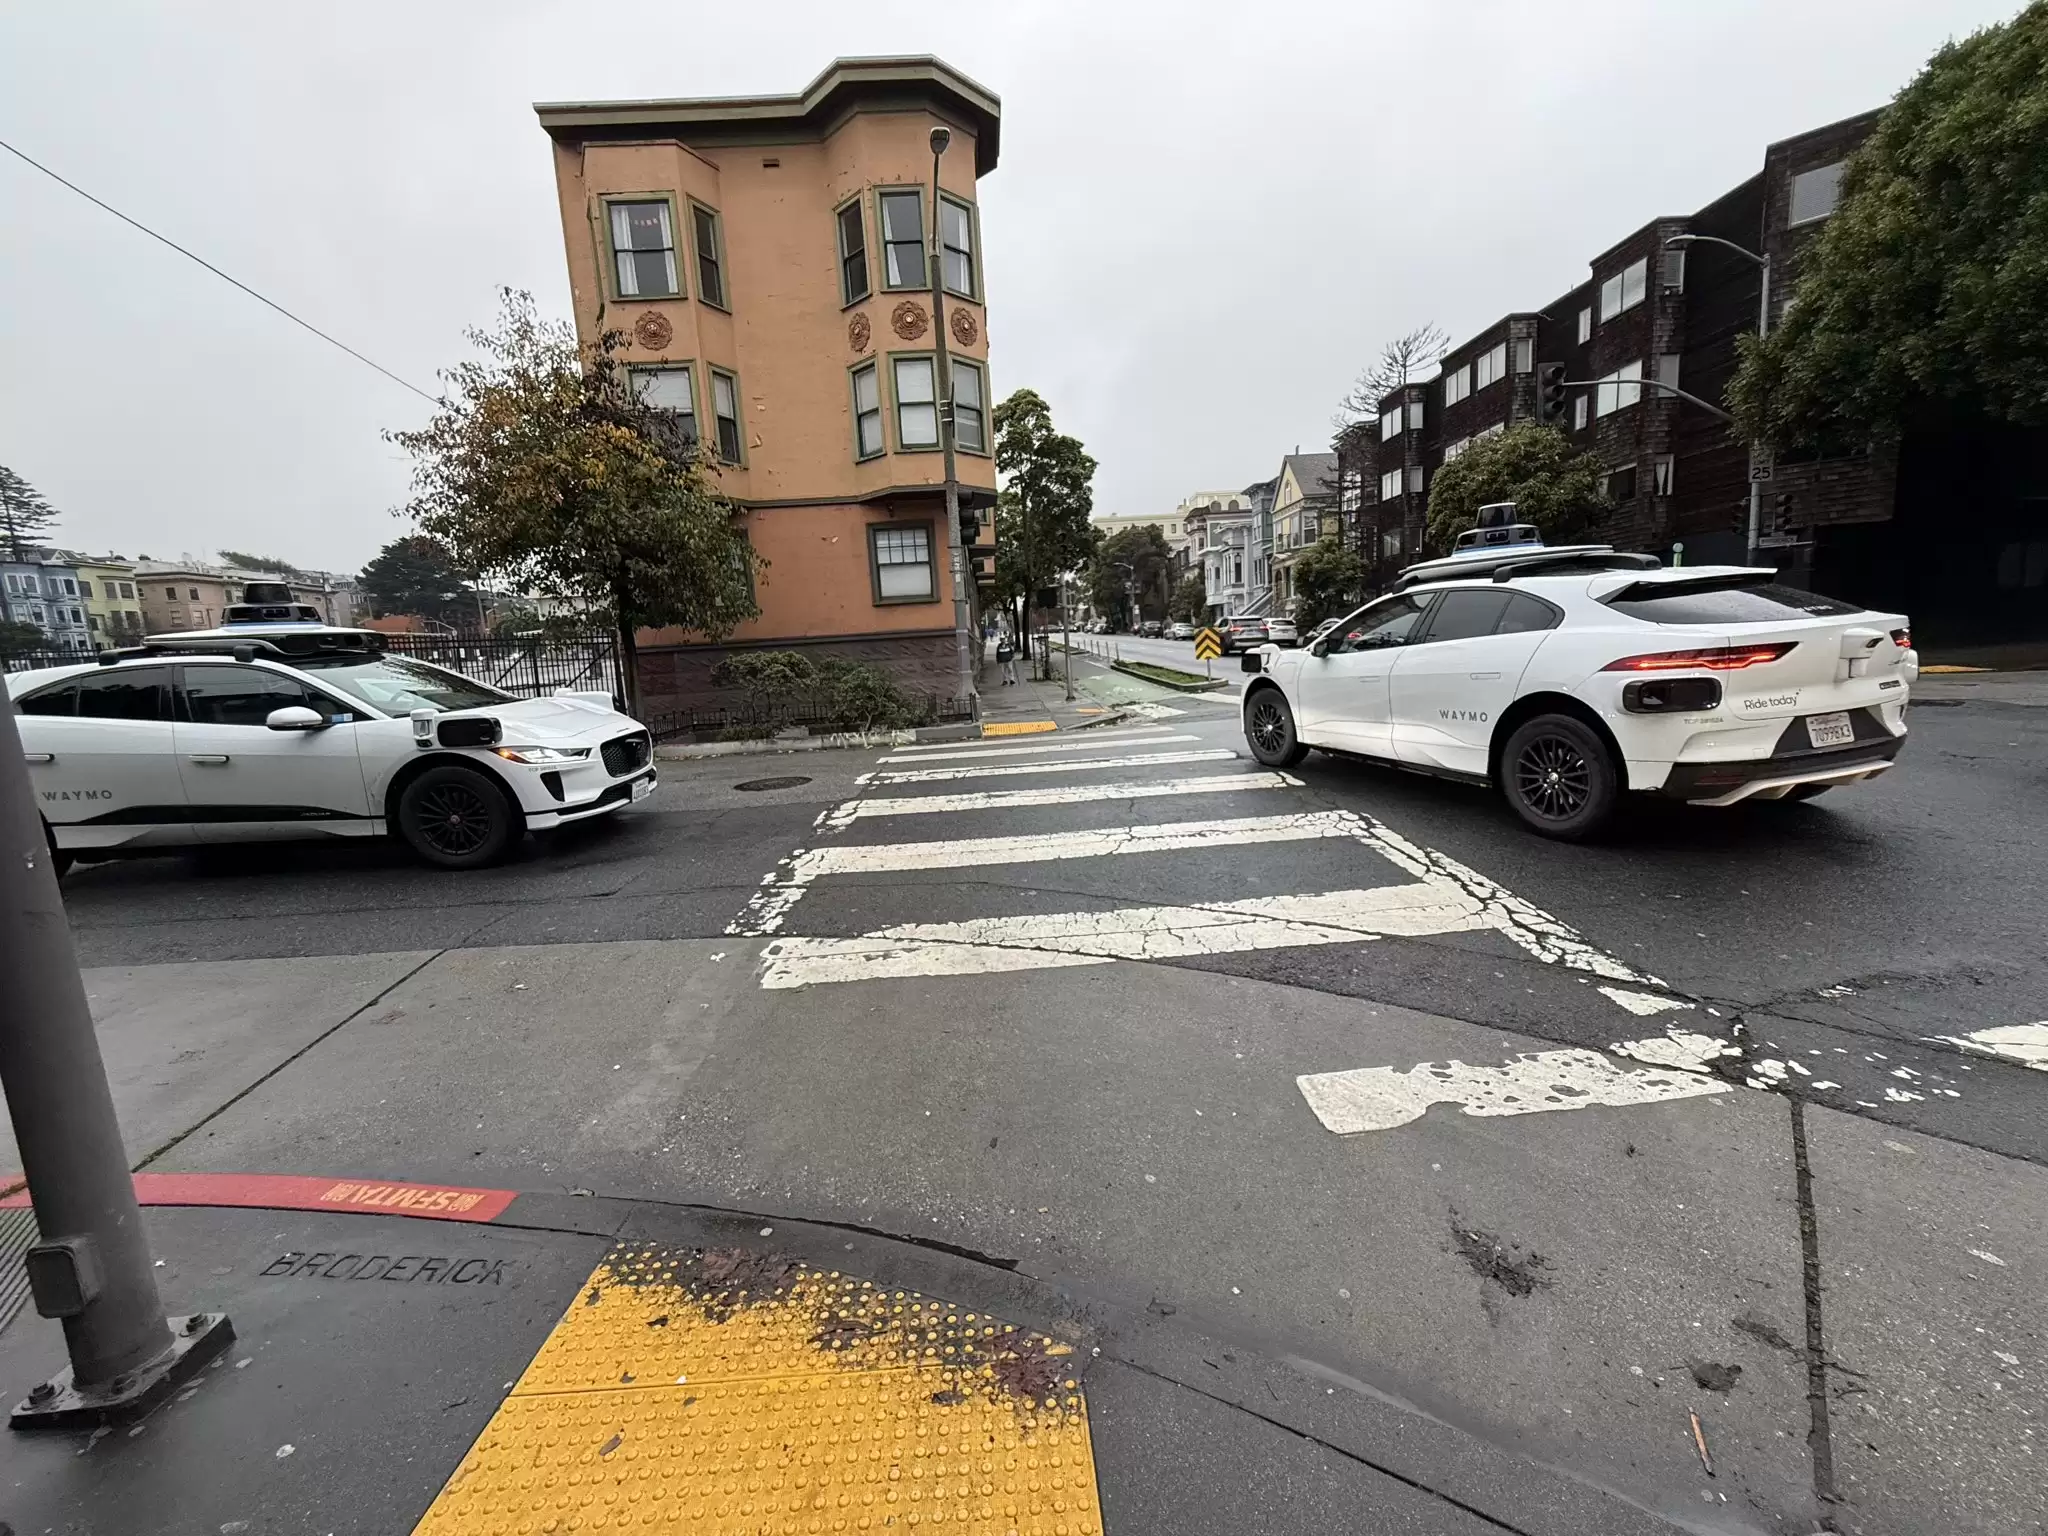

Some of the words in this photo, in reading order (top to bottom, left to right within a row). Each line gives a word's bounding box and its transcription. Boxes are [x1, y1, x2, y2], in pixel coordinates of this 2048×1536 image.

[1752, 467, 1770, 480] 25
[1743, 699, 1768, 711] Ride
[1769, 695, 1797, 707] today
[1439, 709, 1489, 723] WAYMO
[42, 789, 113, 802] WAYMO
[349, 1184, 461, 1210] SFMTA
[258, 1251, 517, 1286] BRODERICK
